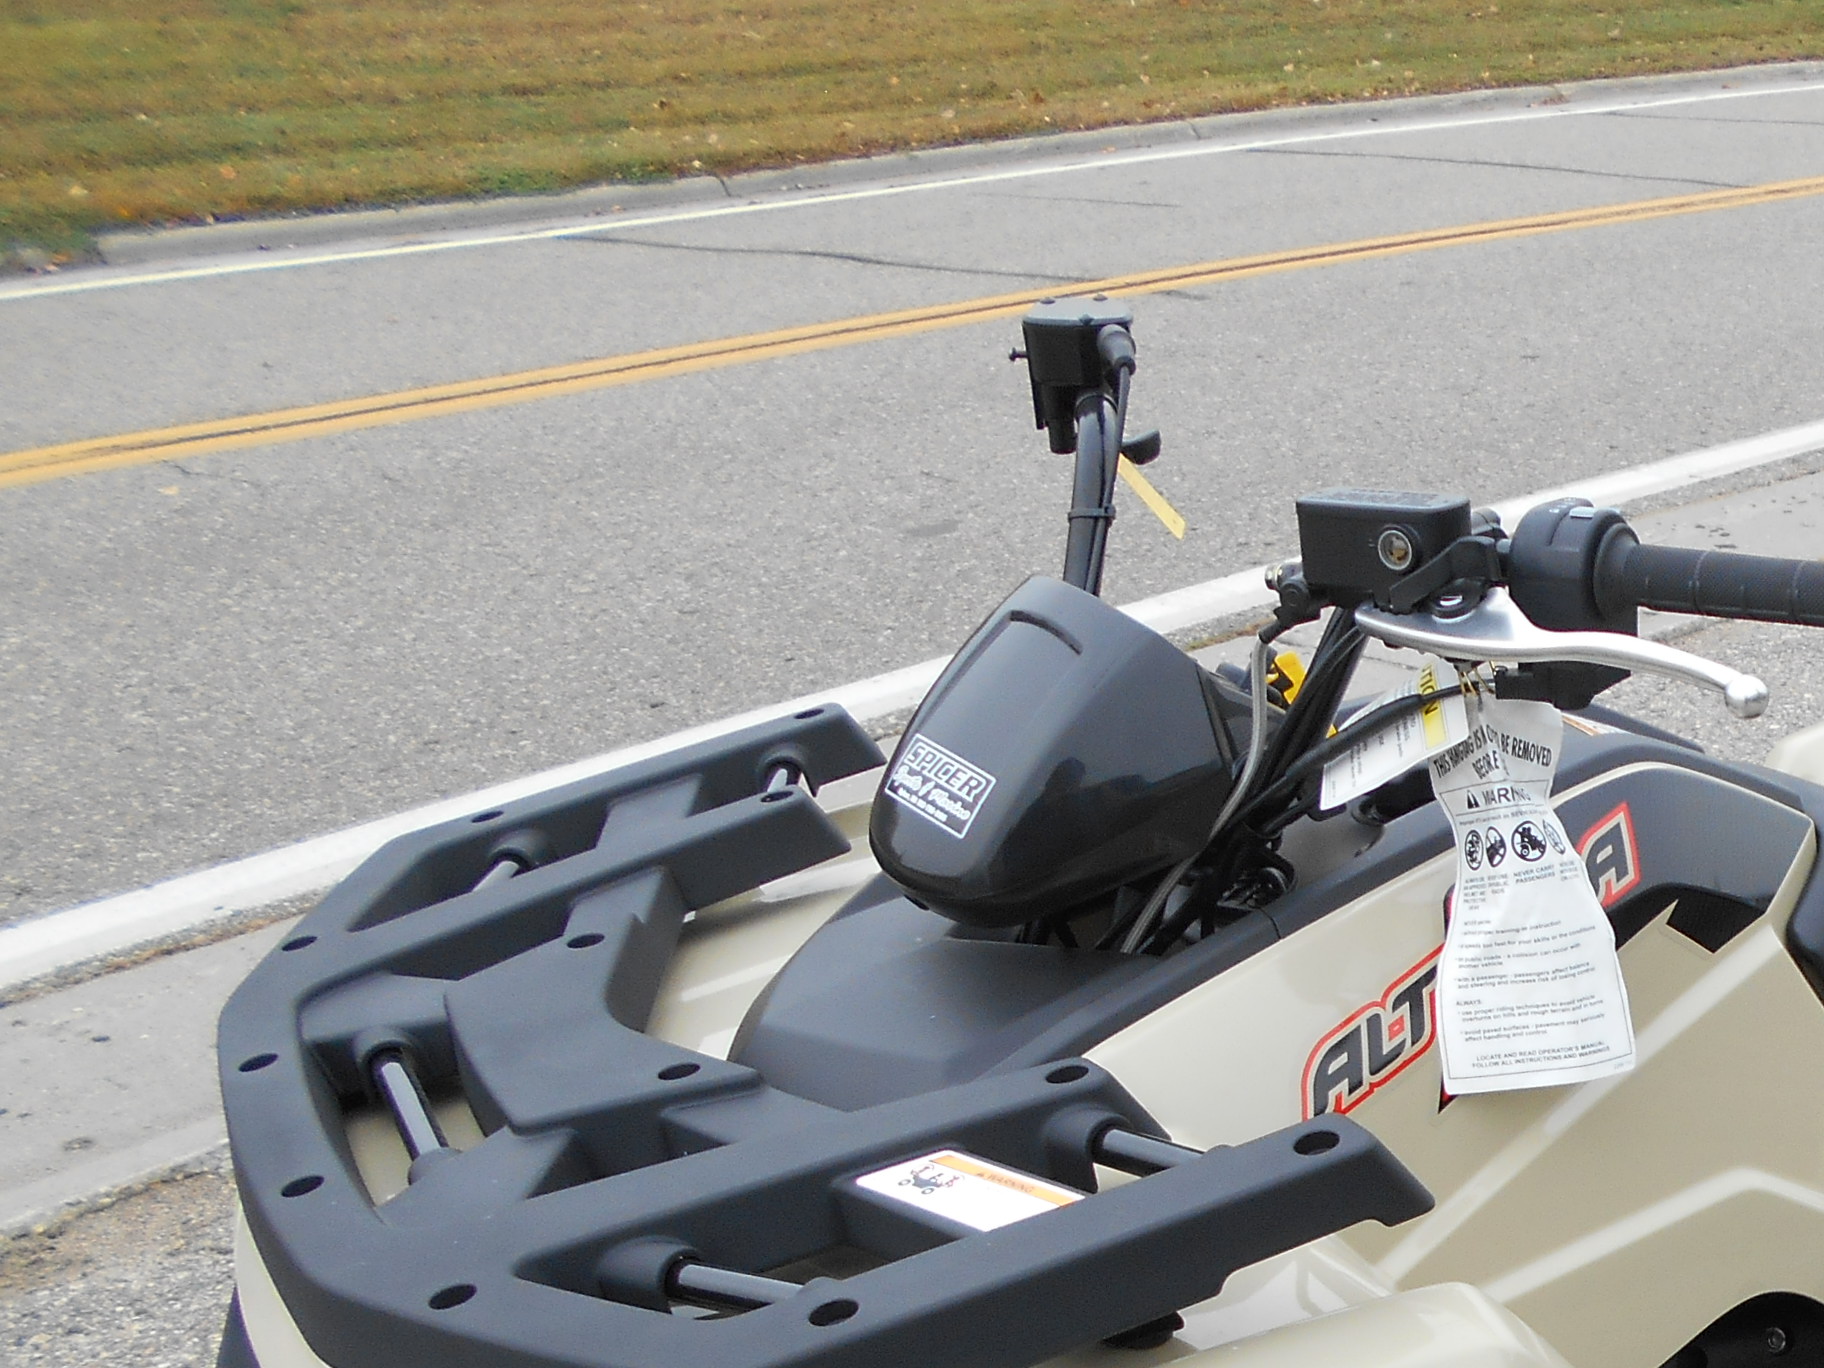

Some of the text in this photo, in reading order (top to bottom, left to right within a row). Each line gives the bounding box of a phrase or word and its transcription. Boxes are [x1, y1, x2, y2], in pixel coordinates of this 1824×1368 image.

[1433, 759, 1451, 778] THIS
[1501, 733, 1511, 754] BE
[1511, 737, 1552, 767] REMOVED
[906, 745, 986, 798] SPICER
[1513, 868, 1534, 878] NEVER
[1515, 871, 1555, 884] PASSENGERS
